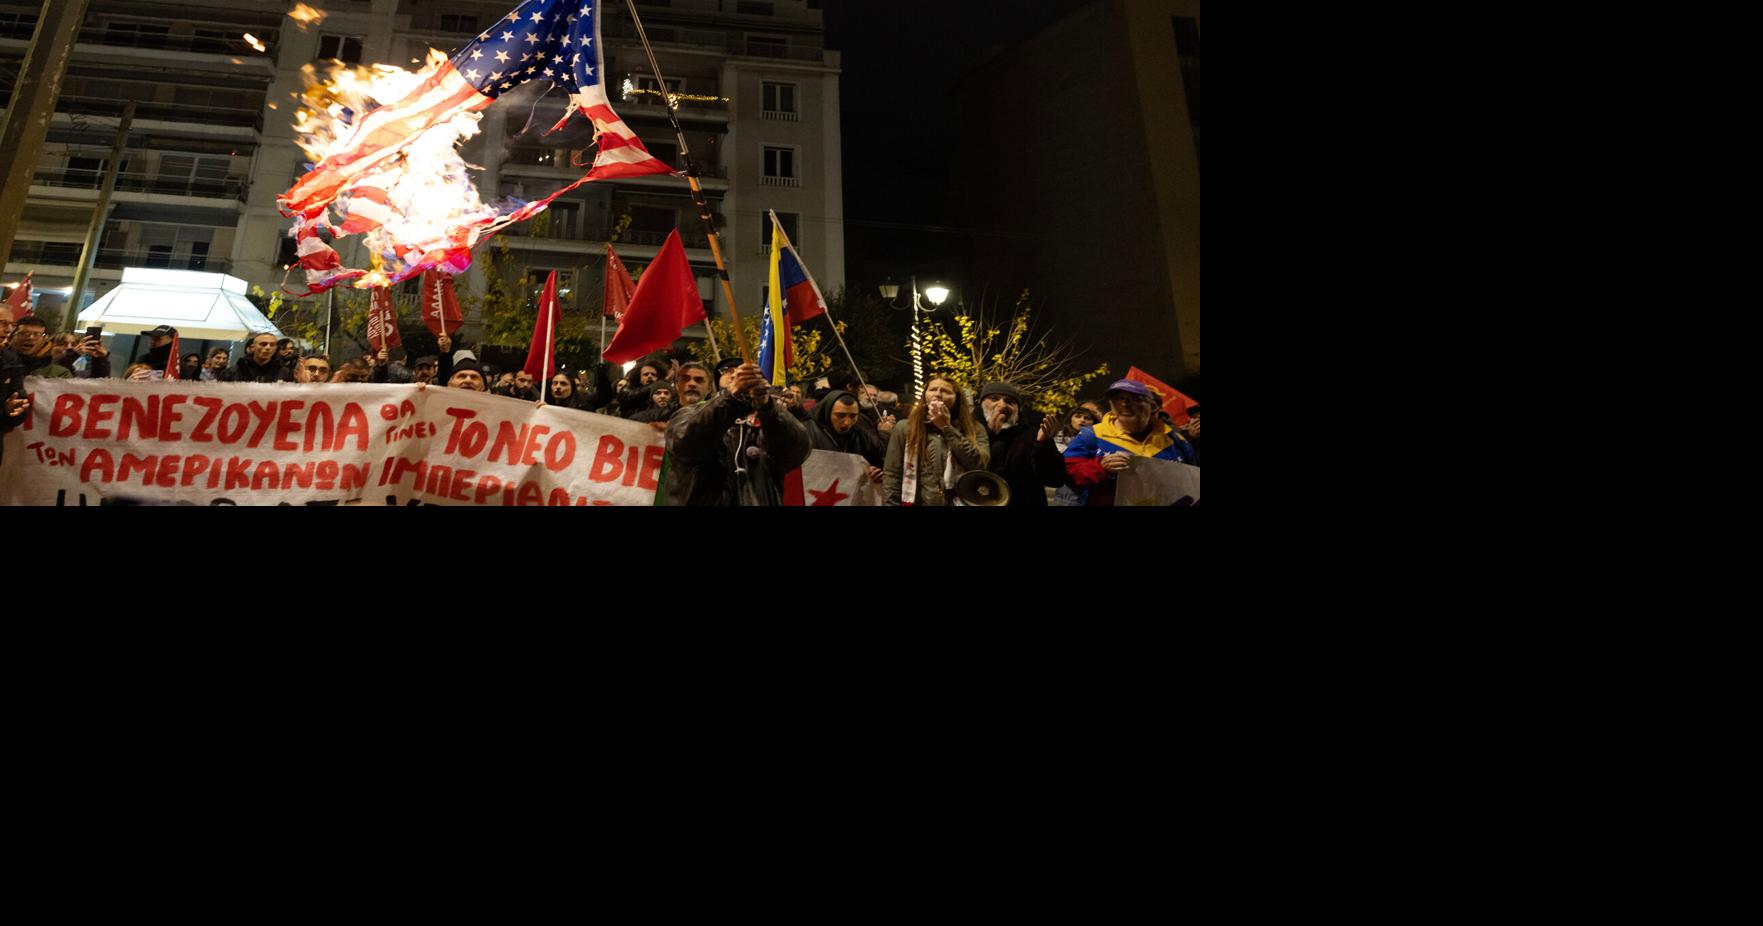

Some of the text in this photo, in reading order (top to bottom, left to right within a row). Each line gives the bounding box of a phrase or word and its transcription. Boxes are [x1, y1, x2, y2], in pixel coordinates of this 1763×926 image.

[49, 393, 369, 451] ΒΕΝΕΖΟΥΕΛΑ
[380, 400, 415, 421] ΘΑ
[385, 421, 437, 445] ΓΙΝΕΙ
[444, 407, 489, 458] ΤΟ
[487, 420, 577, 472] ΝΕΟ
[26, 441, 76, 467] ΤΩΝ
[80, 448, 371, 490] ΑΜΕΡΙΚΑΝΩΝ
